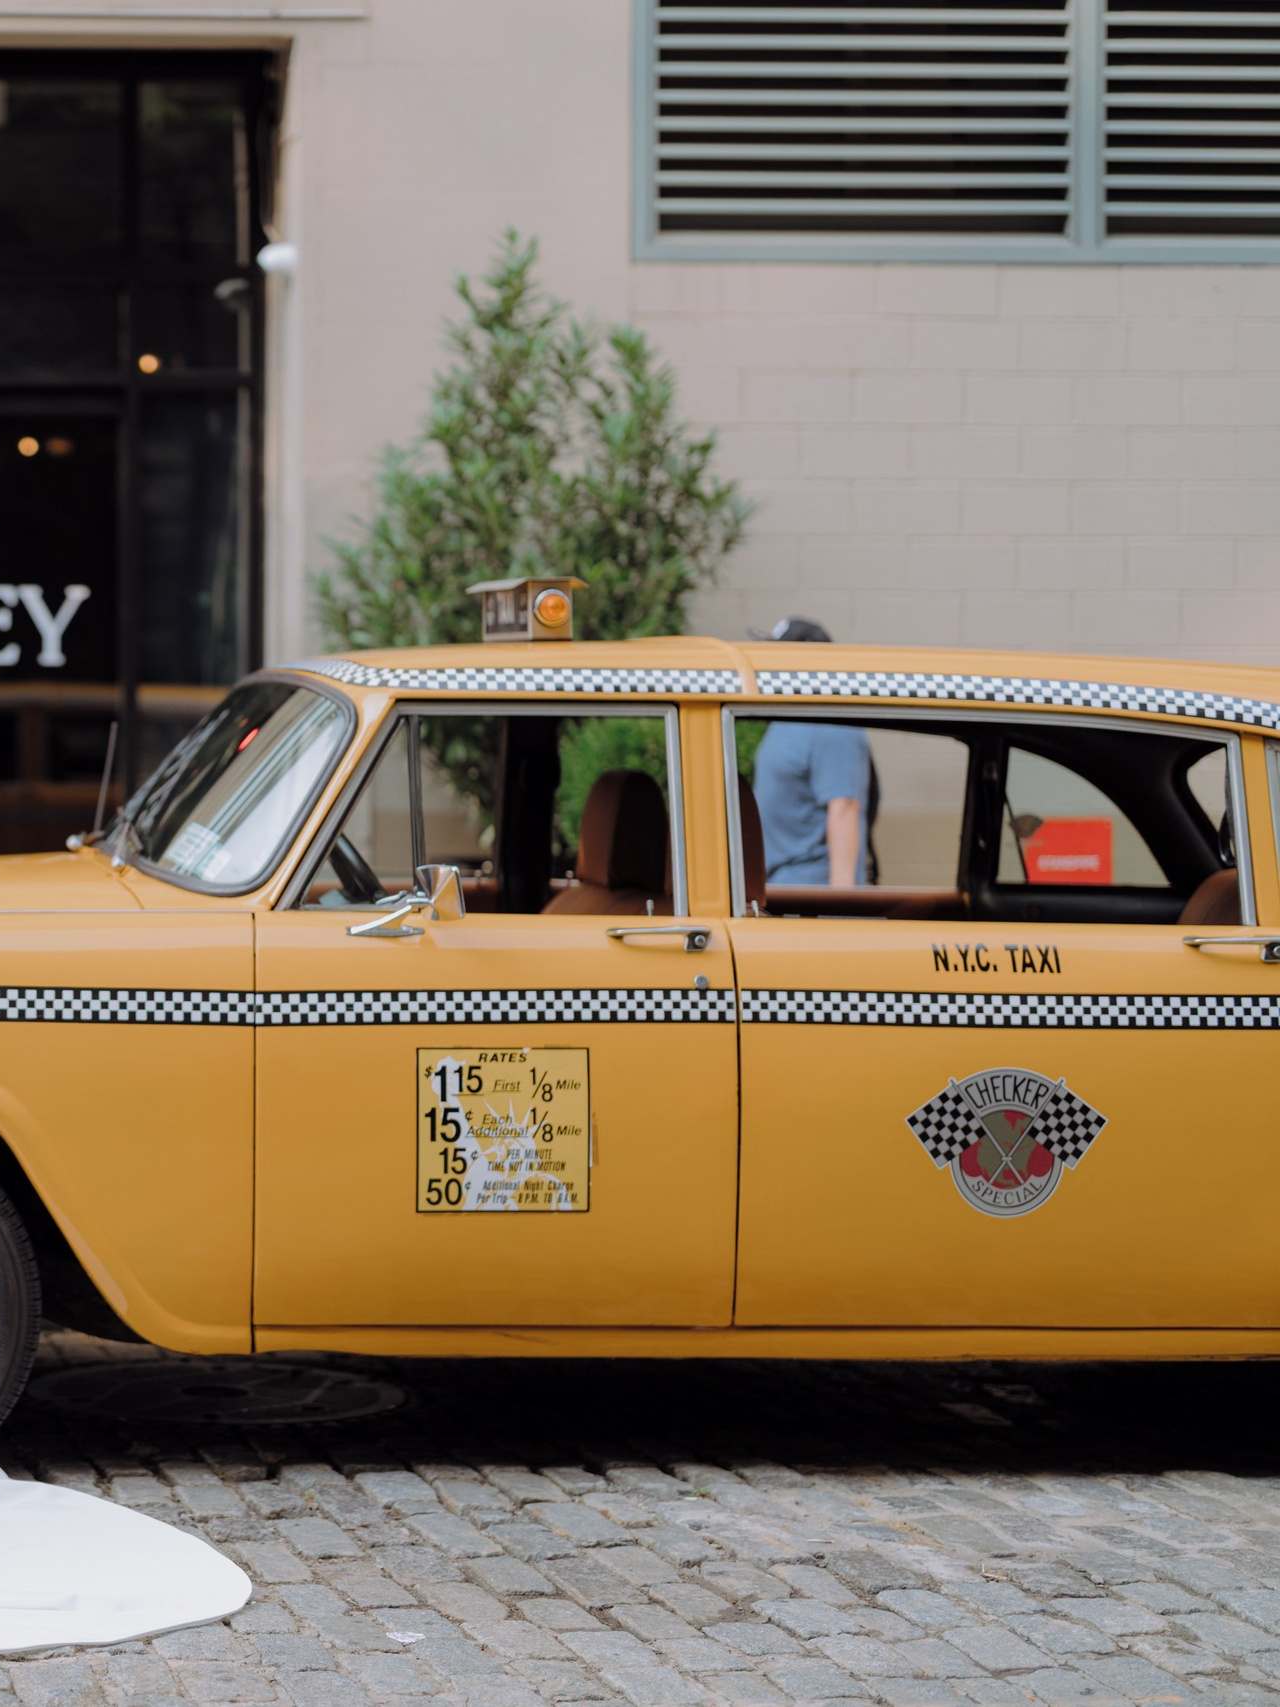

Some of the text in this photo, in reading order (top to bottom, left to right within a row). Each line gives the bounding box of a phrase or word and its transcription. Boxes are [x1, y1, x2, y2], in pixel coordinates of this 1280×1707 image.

[932, 943, 1061, 973] N.Y.C. TAXI
[478, 1052, 527, 1063] RATES
[493, 1080, 521, 1092] First
[555, 1079, 582, 1090] Mile
[964, 1074, 1049, 1109] CHECKER
[467, 1125, 528, 1137] Additional
[483, 1114, 513, 1125] Each
[556, 1126, 582, 1136] Mile
[506, 1149, 521, 1160] PER
[525, 1149, 553, 1160] MINUTE
[487, 1161, 566, 1172] TIME NOT IN MOTION
[483, 1180, 520, 1191] Additional
[524, 1180, 544, 1192] Night
[548, 1180, 574, 1192] Charge
[477, 1193, 491, 1203] Per
[493, 1193, 508, 1205] Trip
[972, 1180, 1042, 1206] SPECIAL
